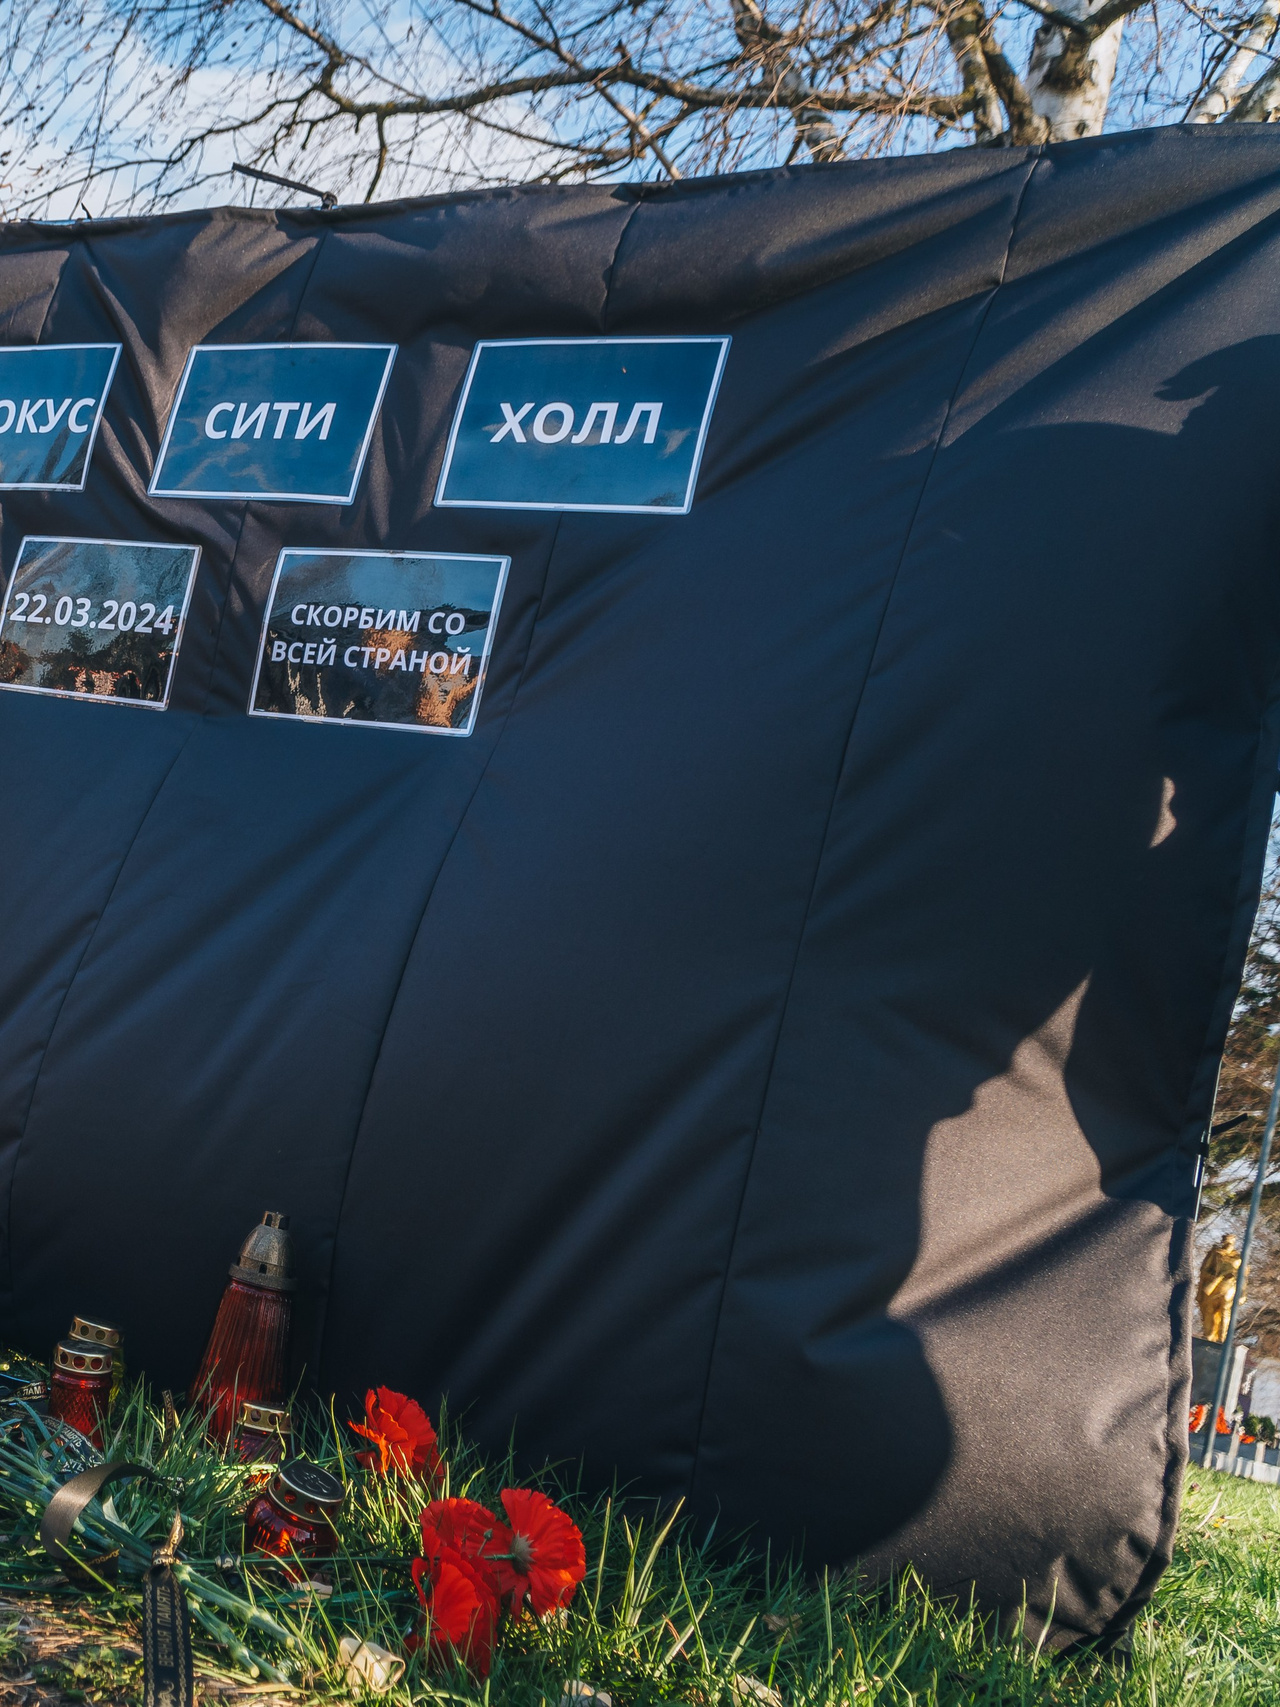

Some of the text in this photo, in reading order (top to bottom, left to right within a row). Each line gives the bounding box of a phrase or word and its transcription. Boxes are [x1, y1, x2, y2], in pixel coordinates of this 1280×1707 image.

[204, 402, 337, 440] СИТИ
[489, 402, 663, 444] ХОЛЛ
[9, 592, 175, 635] 22.03.2024
[291, 604, 466, 636] СКОРБИМ СО
[271, 636, 472, 677] ВСЕЙ СТРАНОЙ
[156, 1585, 172, 1627] ПАМЯТЬ
